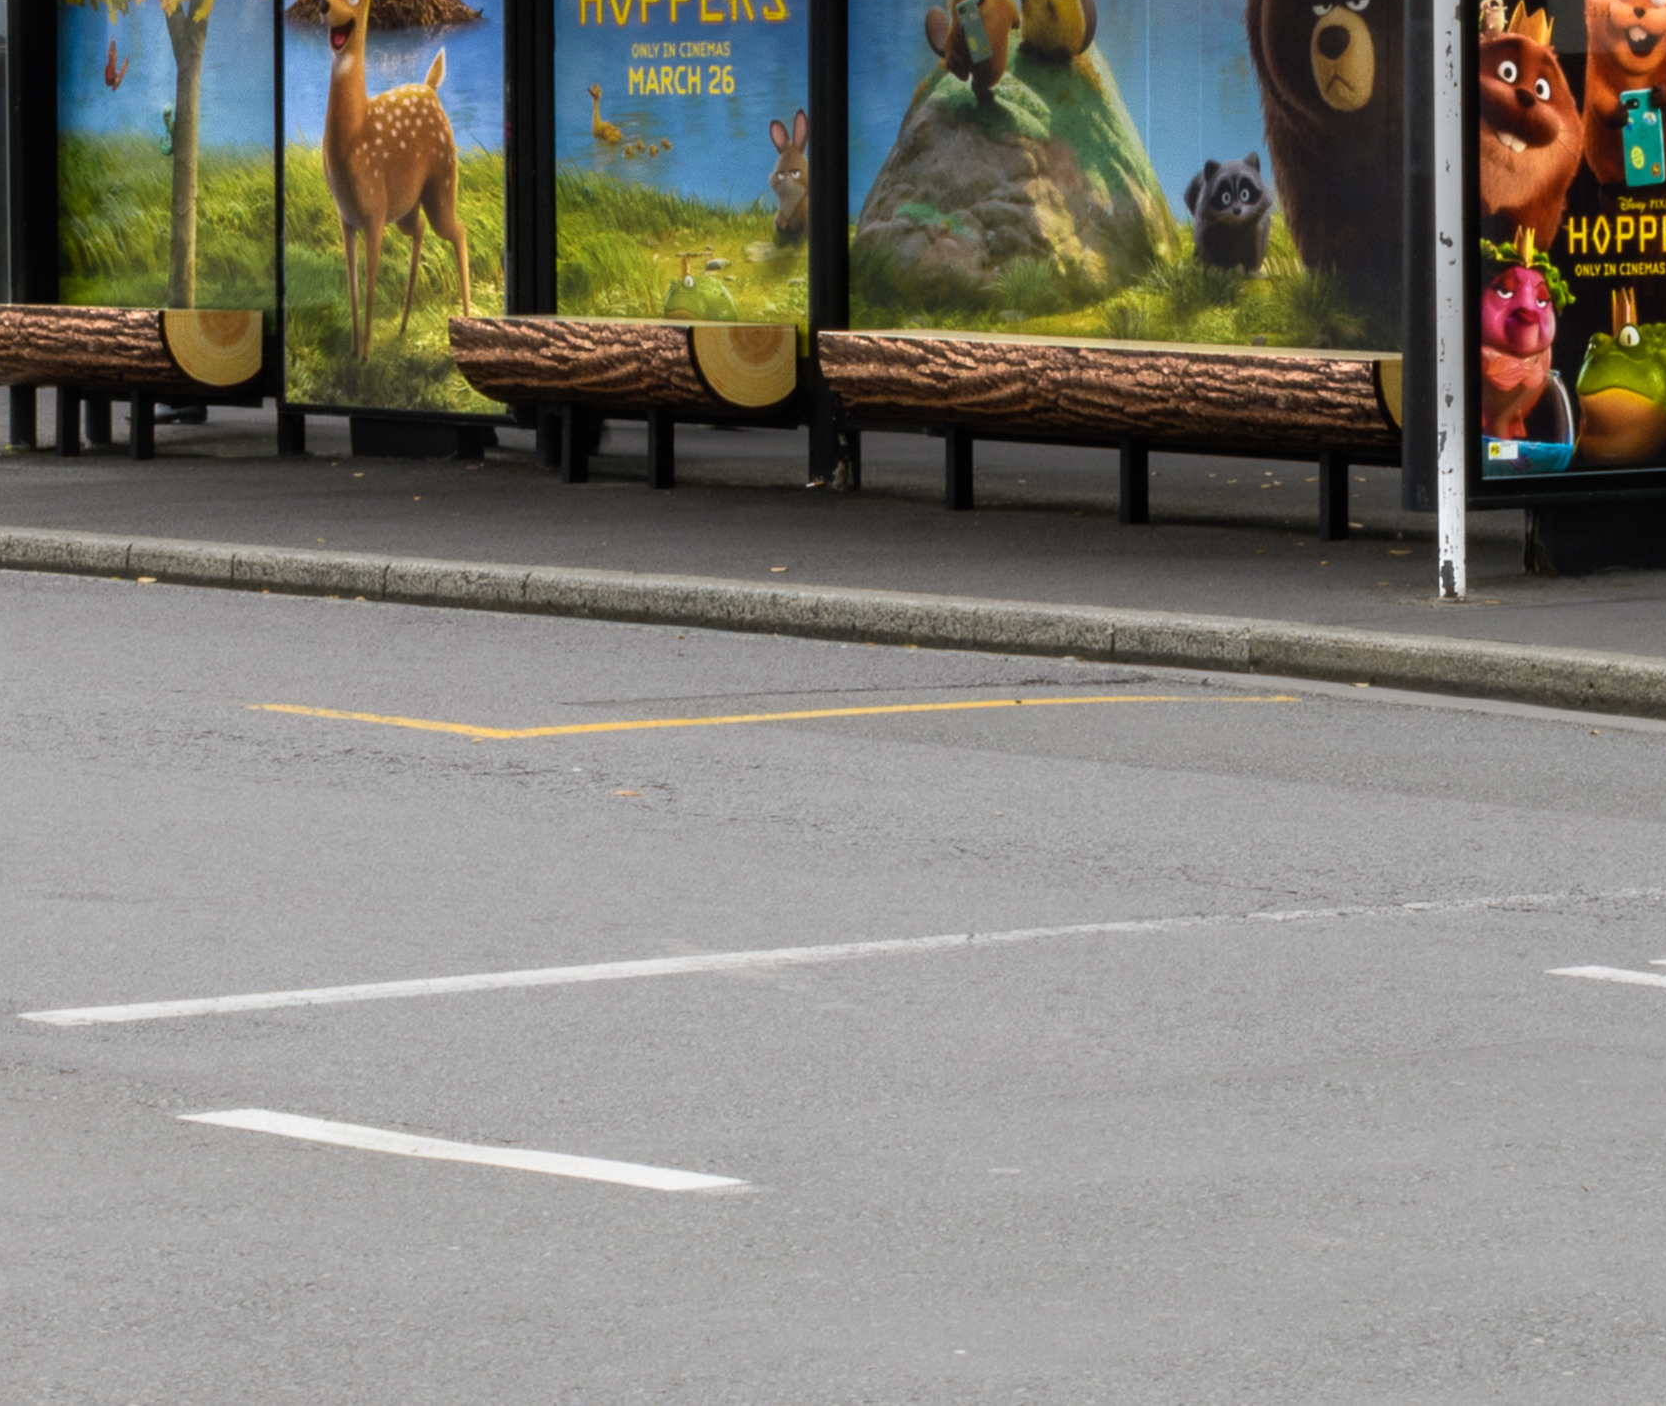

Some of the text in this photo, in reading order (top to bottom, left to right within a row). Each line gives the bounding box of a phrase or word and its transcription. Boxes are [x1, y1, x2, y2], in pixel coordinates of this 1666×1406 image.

[631, 41, 731, 59] ONLY IN CINEMAS
[628, 65, 736, 95] MARCH 26
[1575, 263, 1602, 277] ONLY
[1604, 263, 1617, 276] IN
[1619, 262, 1666, 276] CINEMAS
